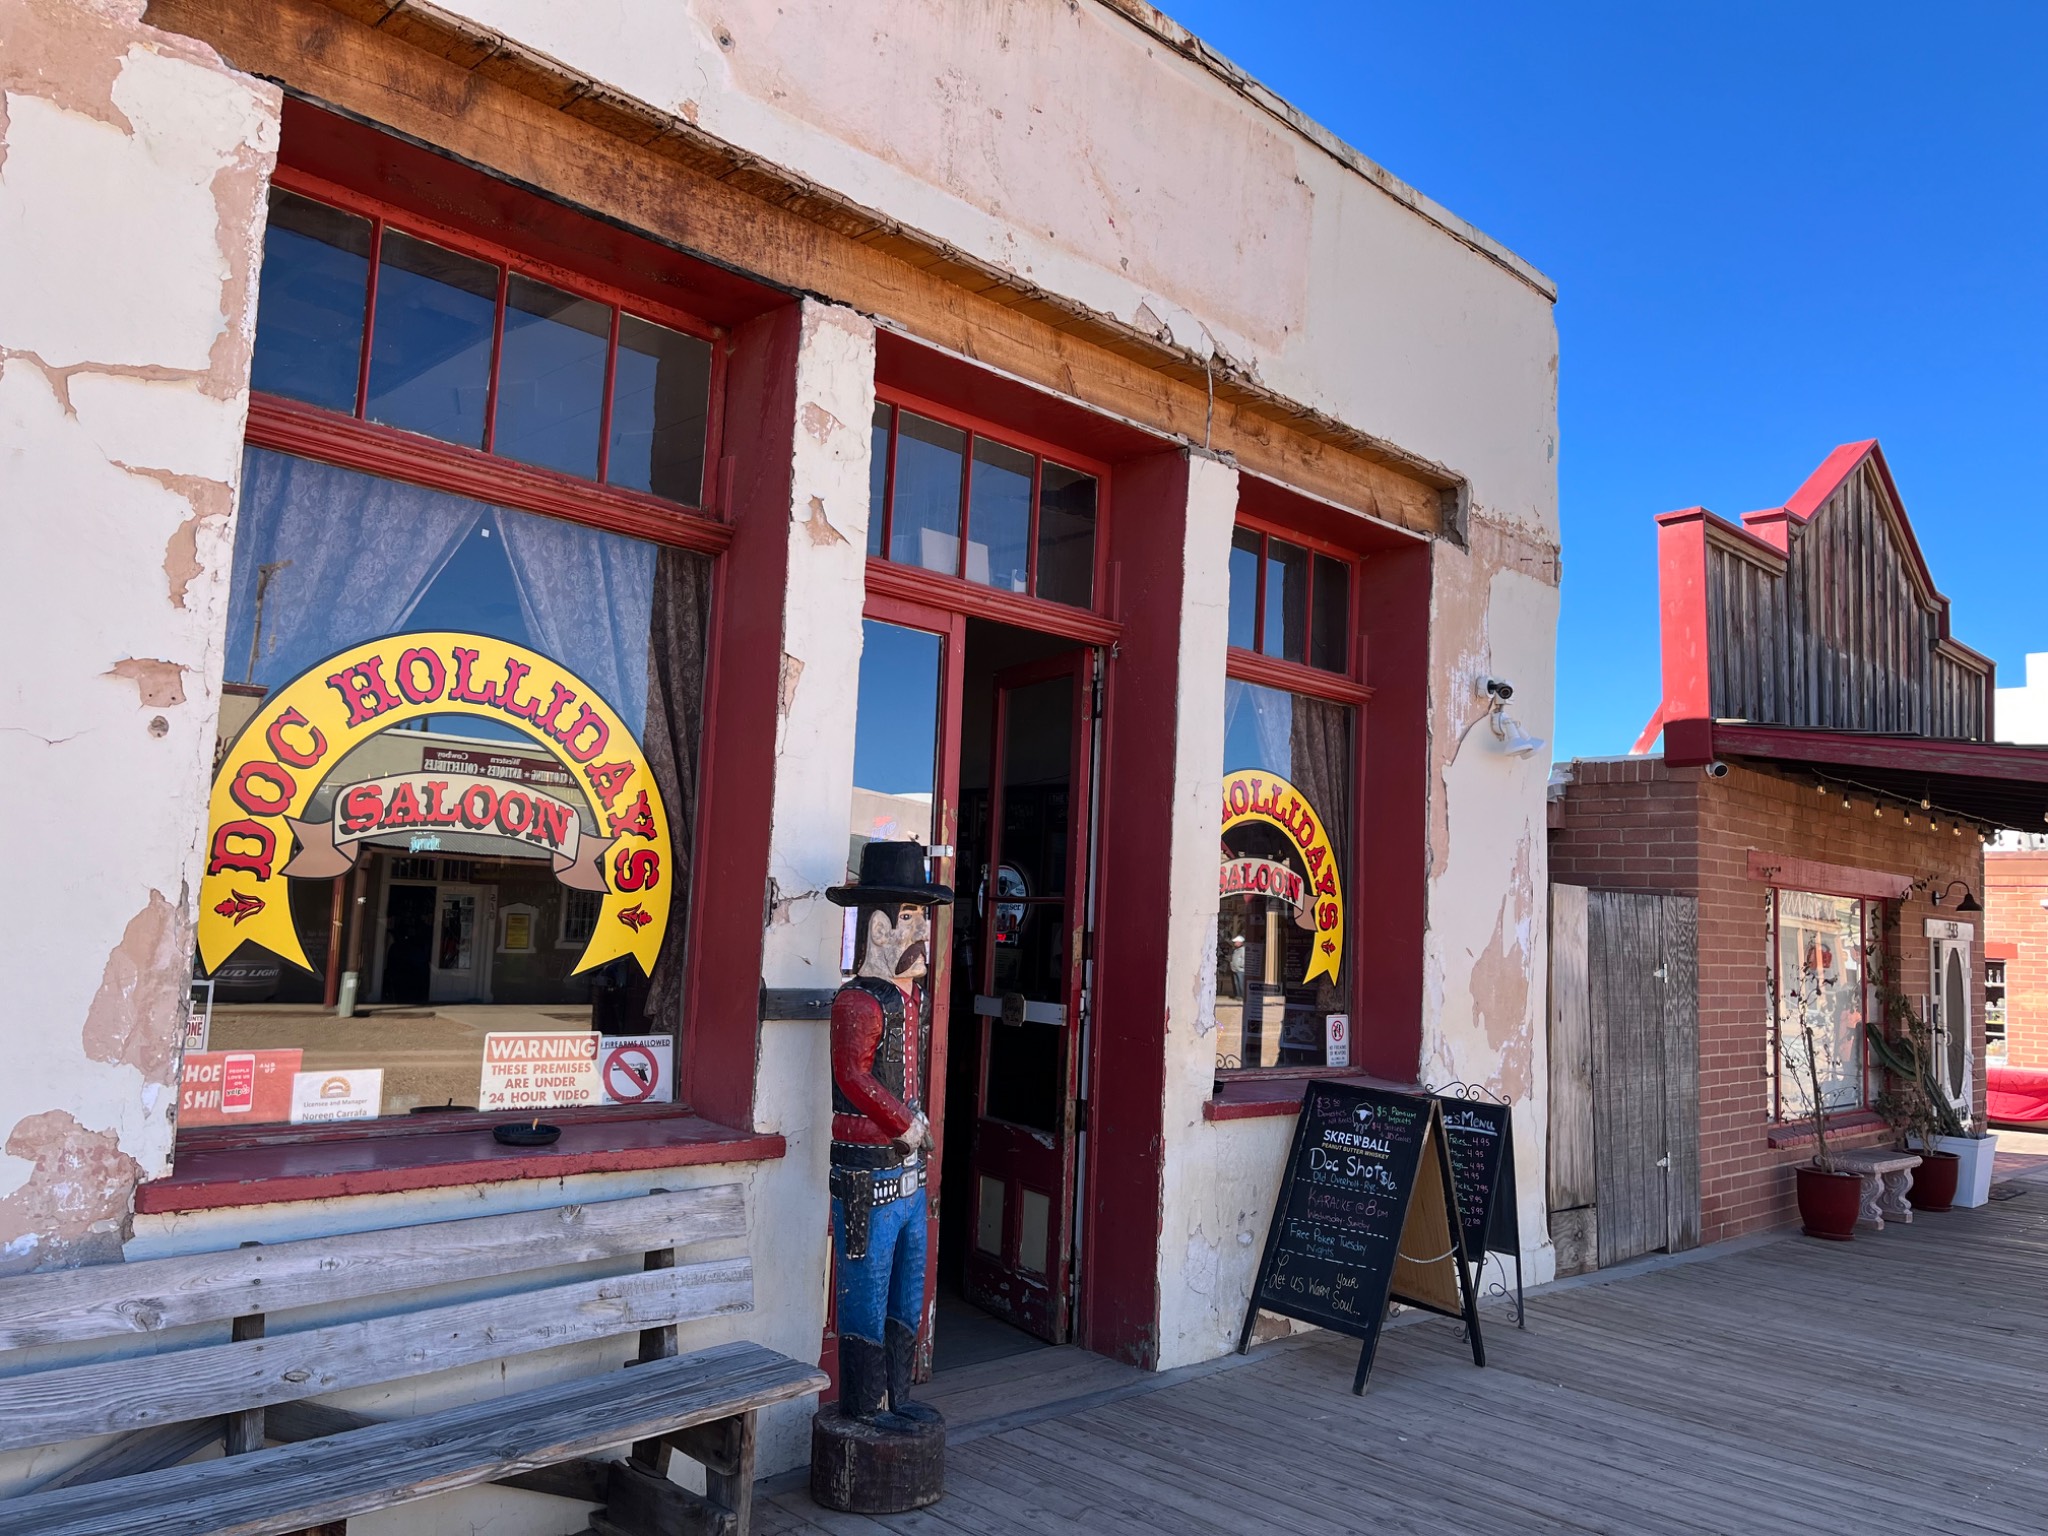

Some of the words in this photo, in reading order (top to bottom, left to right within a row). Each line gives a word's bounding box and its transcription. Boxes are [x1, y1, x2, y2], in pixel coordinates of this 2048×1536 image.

[206, 706, 328, 881] DOC
[327, 647, 660, 893] HOLLIDAYS
[339, 781, 574, 849] SALOON
[248, 968, 280, 977] LIGHT
[490, 1038, 596, 1059] WARNING
[604, 1040, 638, 1049] FIREARMS
[639, 1038, 671, 1048] ALLOWED
[491, 1064, 527, 1076] THESE
[533, 1062, 592, 1075] PREMISES
[505, 1078, 529, 1089] ARE
[535, 1076, 576, 1088] UNDER
[489, 1093, 505, 1104] 24
[511, 1091, 546, 1102] HOUR
[553, 1089, 590, 1101] VIDEO
[302, 1111, 334, 1121] Noreen
[336, 1109, 367, 1119] Carrafa
[1323, 1130, 1391, 1152] SKREWBALL
[1310, 1148, 1339, 1171] Doc
[1321, 1142, 1342, 1151] PEANUT
[1343, 1146, 1363, 1155] BUTTER
[1364, 1150, 1389, 1160] WHISKEY
[1308, 1187, 1354, 1211] KARAOKE
[1339, 1234, 1367, 1256] Tuesday
